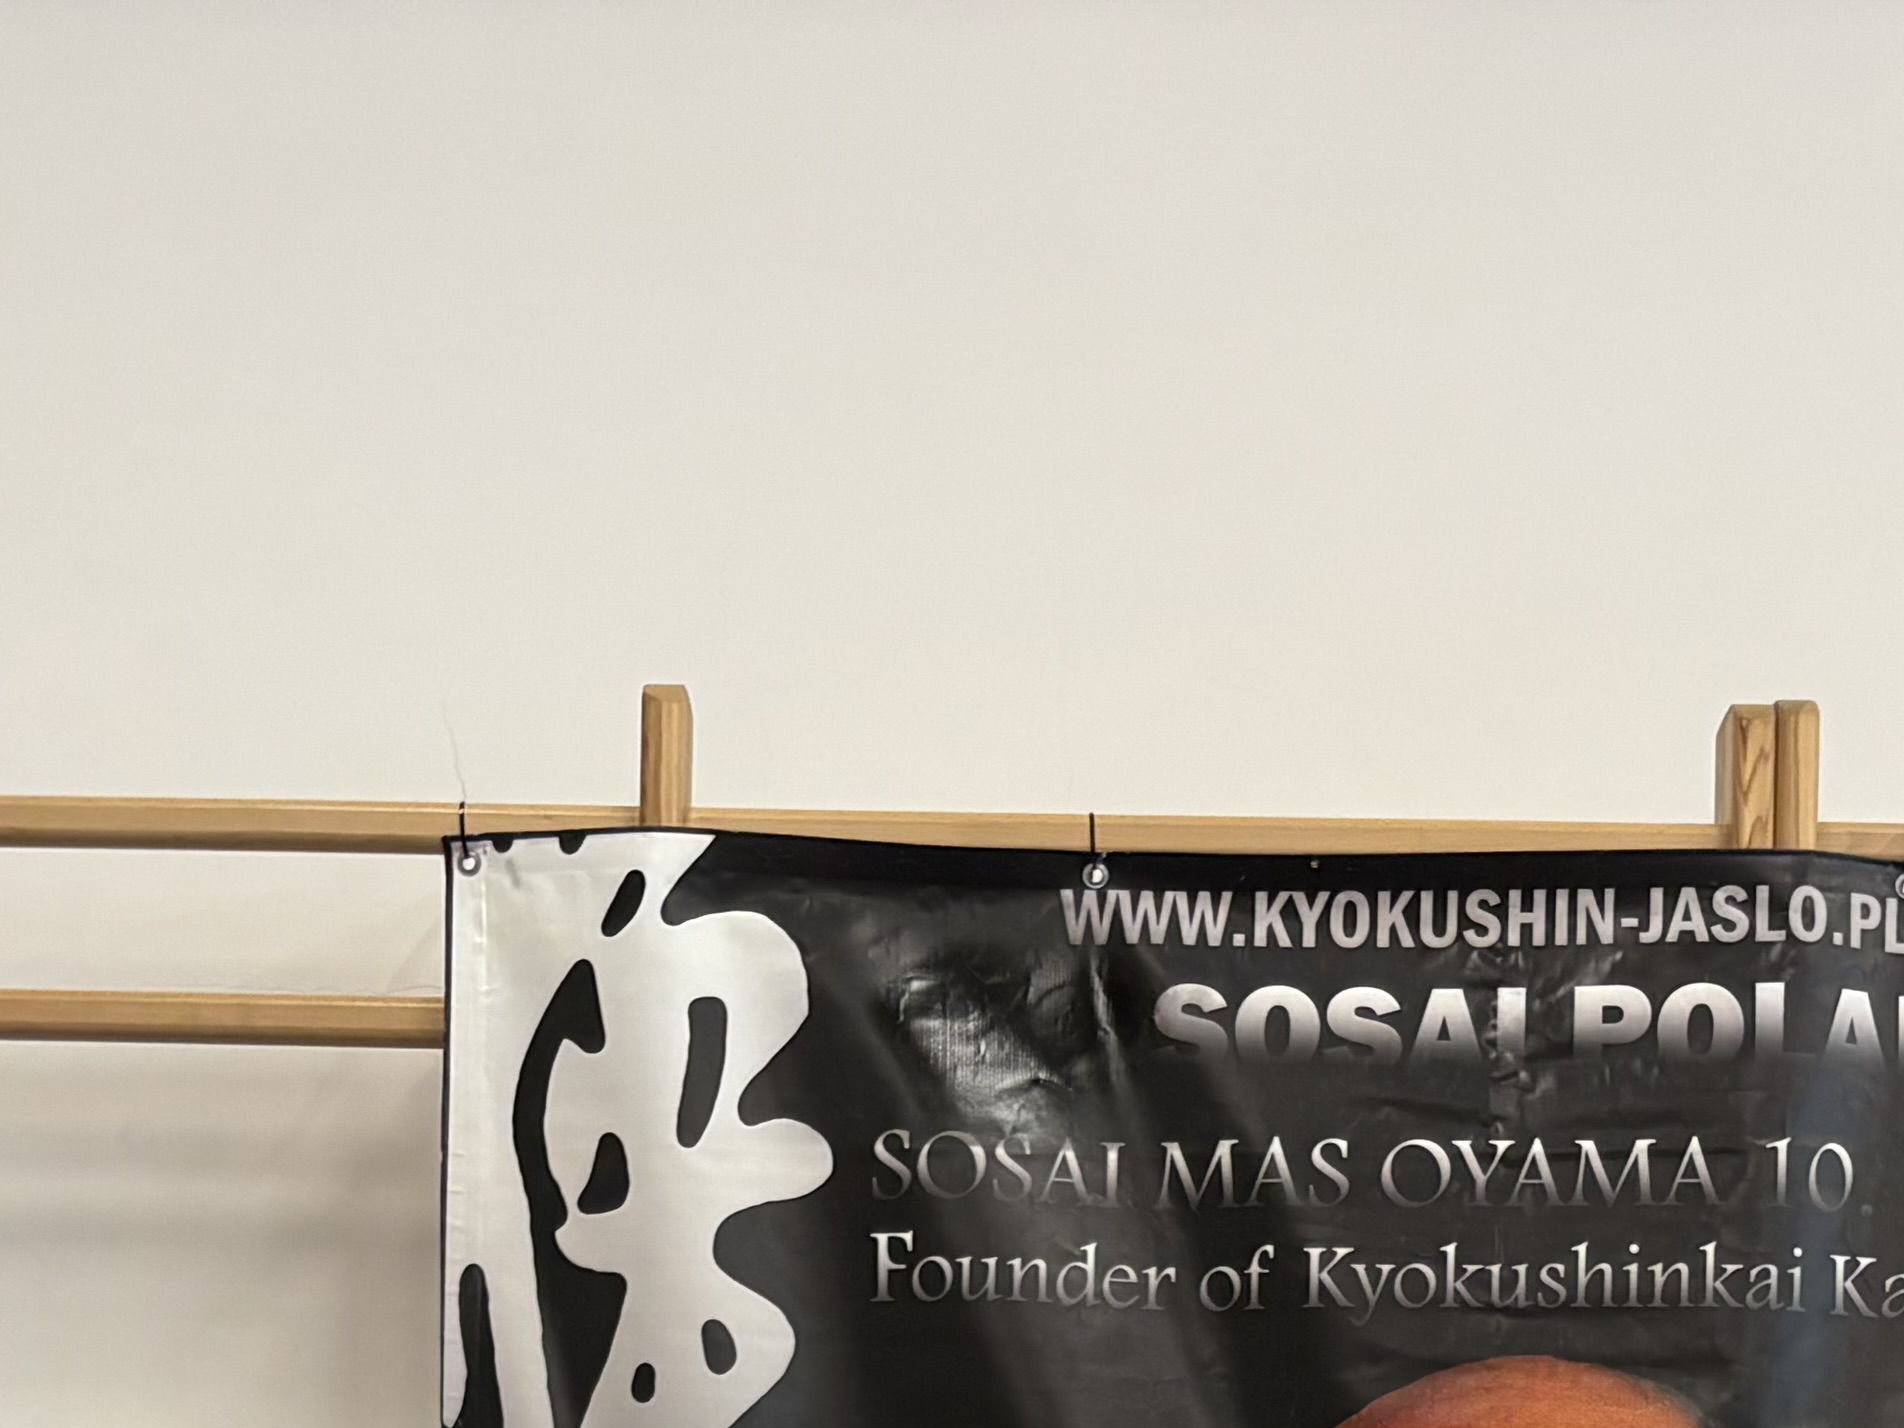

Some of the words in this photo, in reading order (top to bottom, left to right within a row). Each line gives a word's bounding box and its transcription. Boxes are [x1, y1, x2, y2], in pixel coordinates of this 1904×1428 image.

[1153, 983, 1527, 1070] SOSAI
[870, 1128, 1124, 1206] SOSAI
[1157, 1137, 1352, 1212] MAS
[1380, 1135, 1721, 1211] OYAMA
[1763, 1137, 1874, 1218] 10.
[869, 1230, 1177, 1312] Founder
[1199, 1245, 1276, 1313] of
[1302, 1241, 1807, 1326] Kyokushinkai
